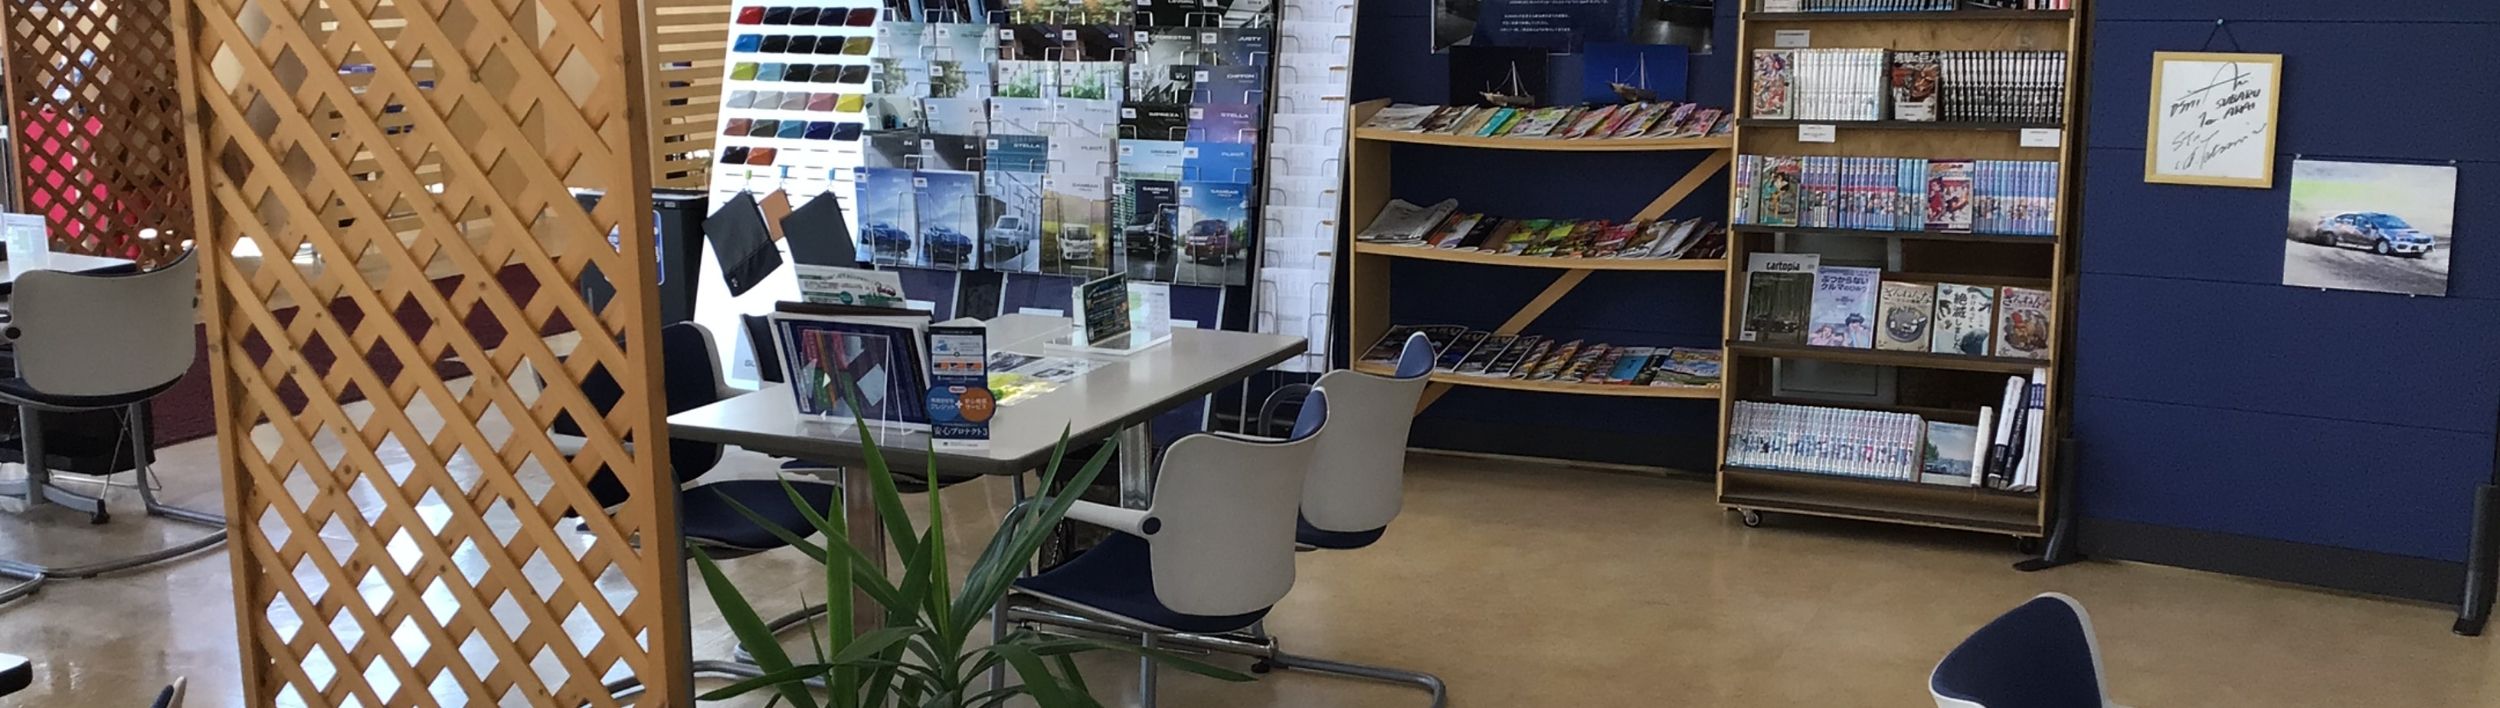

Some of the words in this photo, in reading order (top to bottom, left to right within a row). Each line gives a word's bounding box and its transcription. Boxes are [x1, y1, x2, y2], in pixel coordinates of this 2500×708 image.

[1766, 261, 1800, 271] cartopia
[1821, 275, 1869, 285] ぶつからない
[934, 426, 988, 437] 安心プロテクト3
